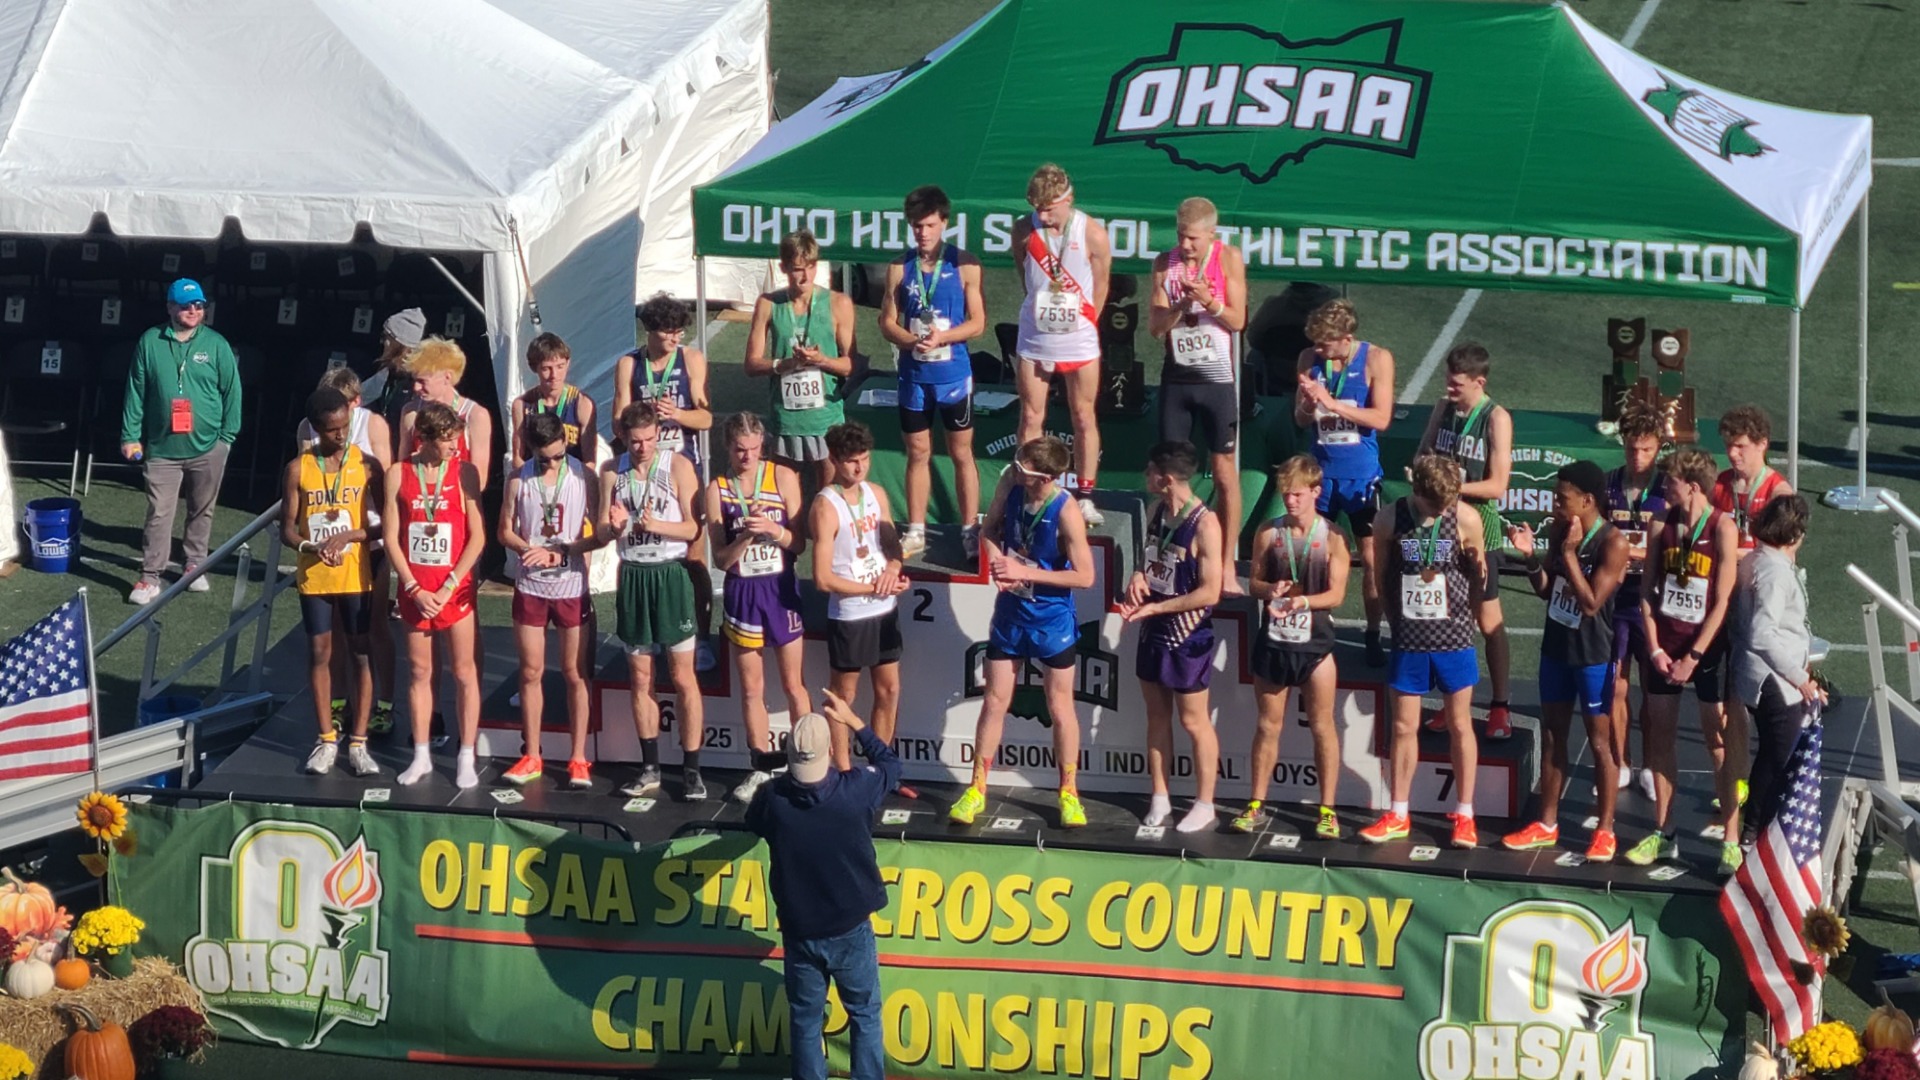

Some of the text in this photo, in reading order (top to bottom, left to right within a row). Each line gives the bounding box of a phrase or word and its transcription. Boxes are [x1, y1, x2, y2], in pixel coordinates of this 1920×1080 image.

[1116, 63, 1413, 142] OHSAA
[722, 203, 1767, 288] OHIO HIH SOL THLETIC ASSOCIATION
[106, 309, 115, 320] 3
[283, 309, 292, 319] 7
[357, 319, 367, 329] 9
[1039, 306, 1076, 323] 7535
[1177, 333, 1213, 354] 6932
[43, 358, 58, 370] 15
[639, 380, 680, 400] WET
[784, 380, 820, 397] 7038
[1497, 487, 1554, 513] HSA
[412, 536, 448, 553] 7519
[742, 544, 778, 563] 7162
[1401, 539, 1453, 562] RERE
[1145, 558, 1174, 583] 787
[913, 588, 935, 622] 2
[1406, 590, 1443, 606] 7428
[1667, 589, 1703, 610] 7555
[658, 700, 676, 732] 6
[960, 743, 1056, 768] DISION
[1105, 750, 1240, 780] INDIIDAL
[1273, 762, 1318, 786] OYS
[1435, 767, 1456, 802] 7
[419, 839, 636, 924] OHSAA
[653, 858, 773, 930] STA
[1087, 880, 1414, 969] COUNTRY
[204, 943, 383, 1011] OHSAA
[249, 997, 279, 1008] SCHOOL
[280, 998, 319, 1010] ATHLETIC
[323, 1003, 373, 1022] ASSOCIATION
[592, 975, 1214, 1080] CHAMONSHIPS
[1428, 1024, 1650, 1080] OHSAA
